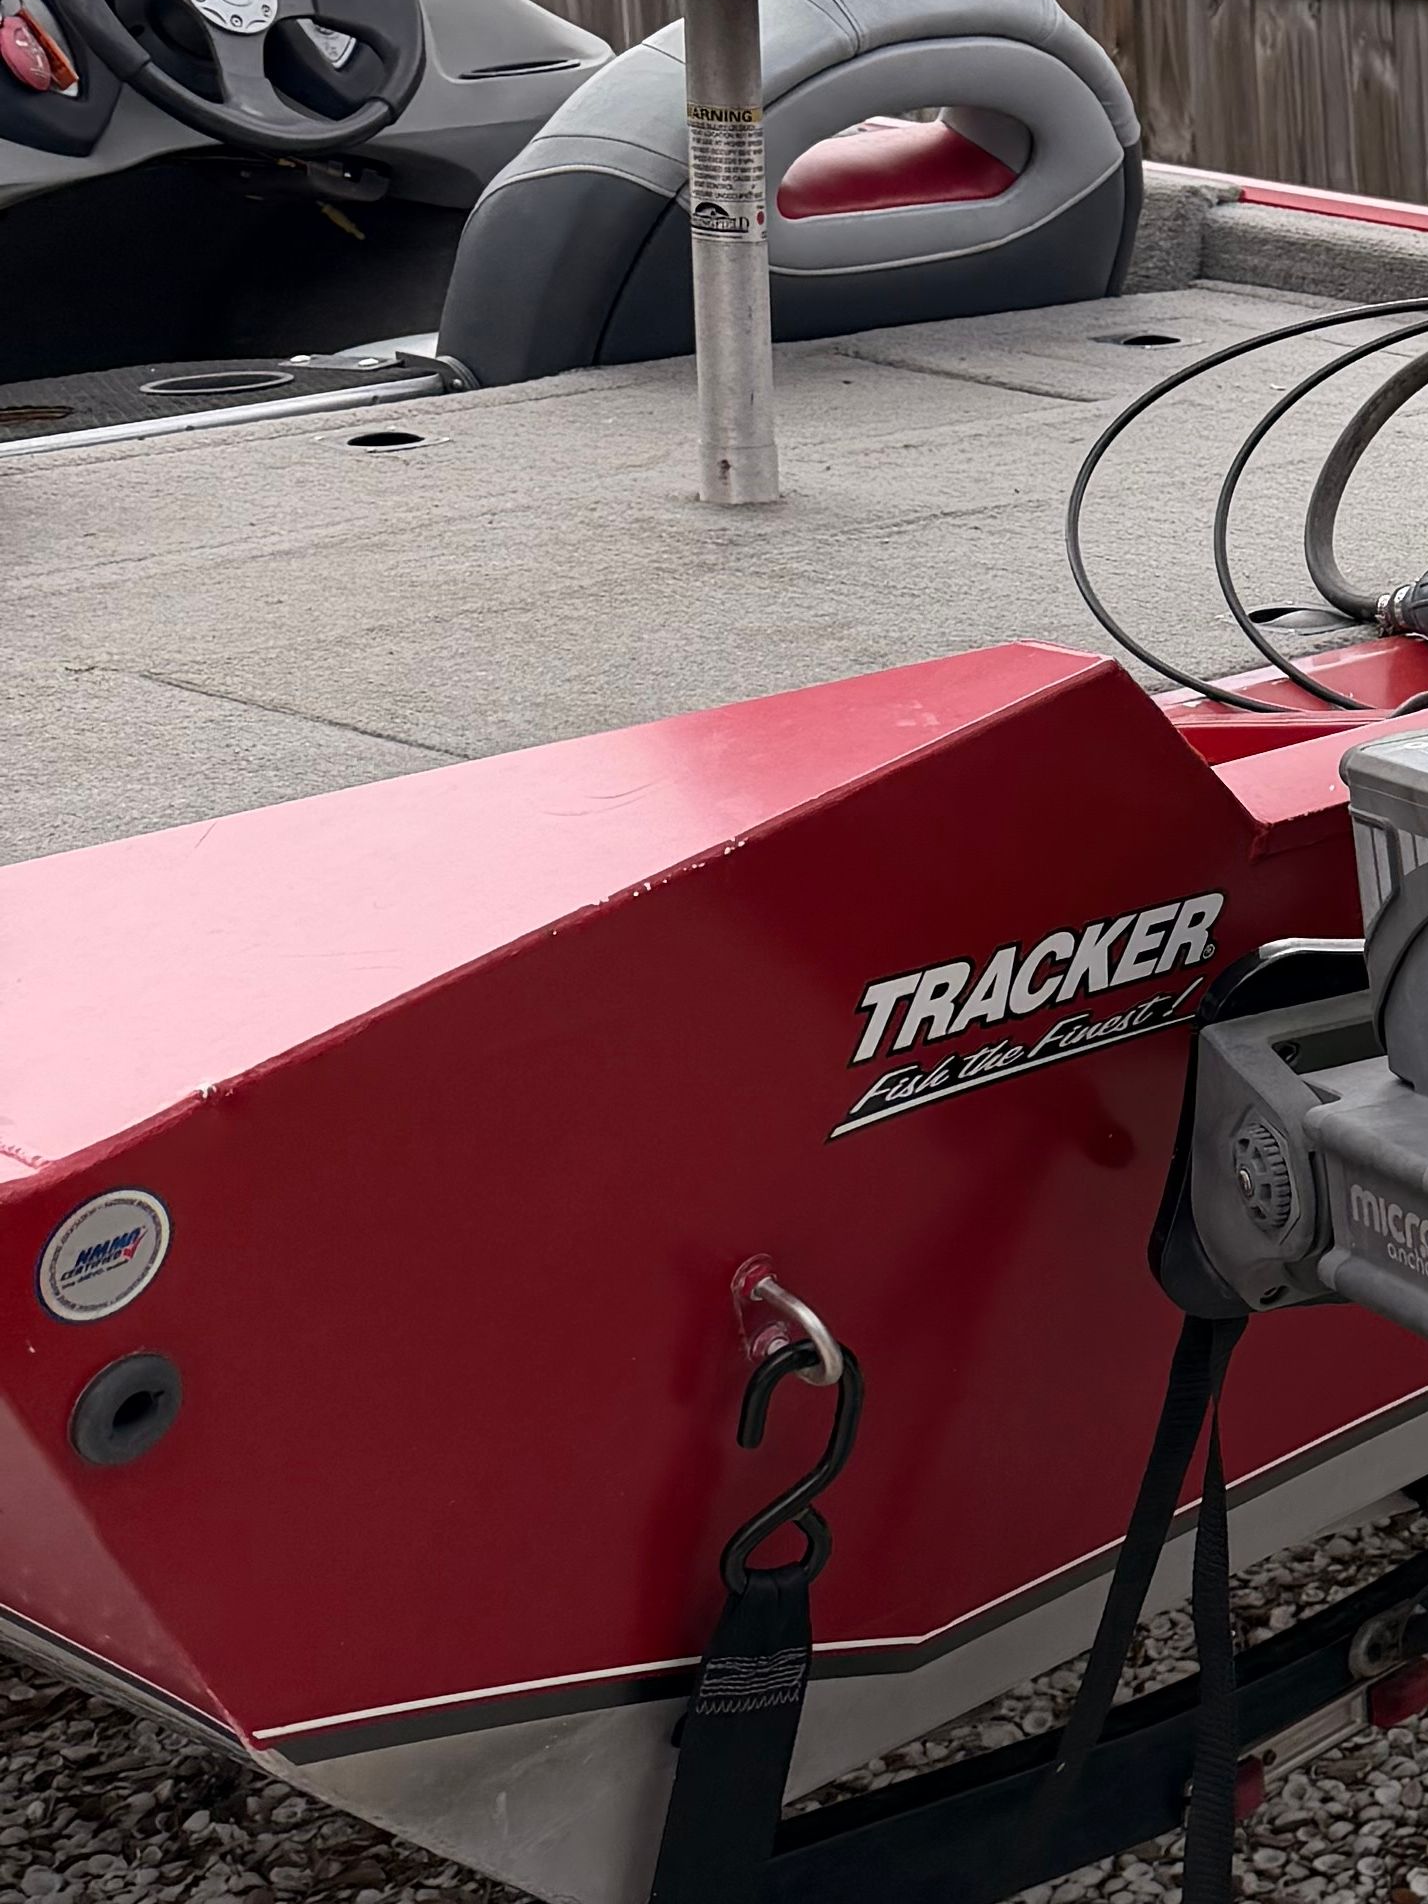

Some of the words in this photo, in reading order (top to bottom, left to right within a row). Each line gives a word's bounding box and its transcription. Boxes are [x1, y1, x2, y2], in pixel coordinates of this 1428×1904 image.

[853, 892, 1225, 1065] TRACKER
[848, 1065, 950, 1115] Fish
[958, 1043, 1024, 1081] the
